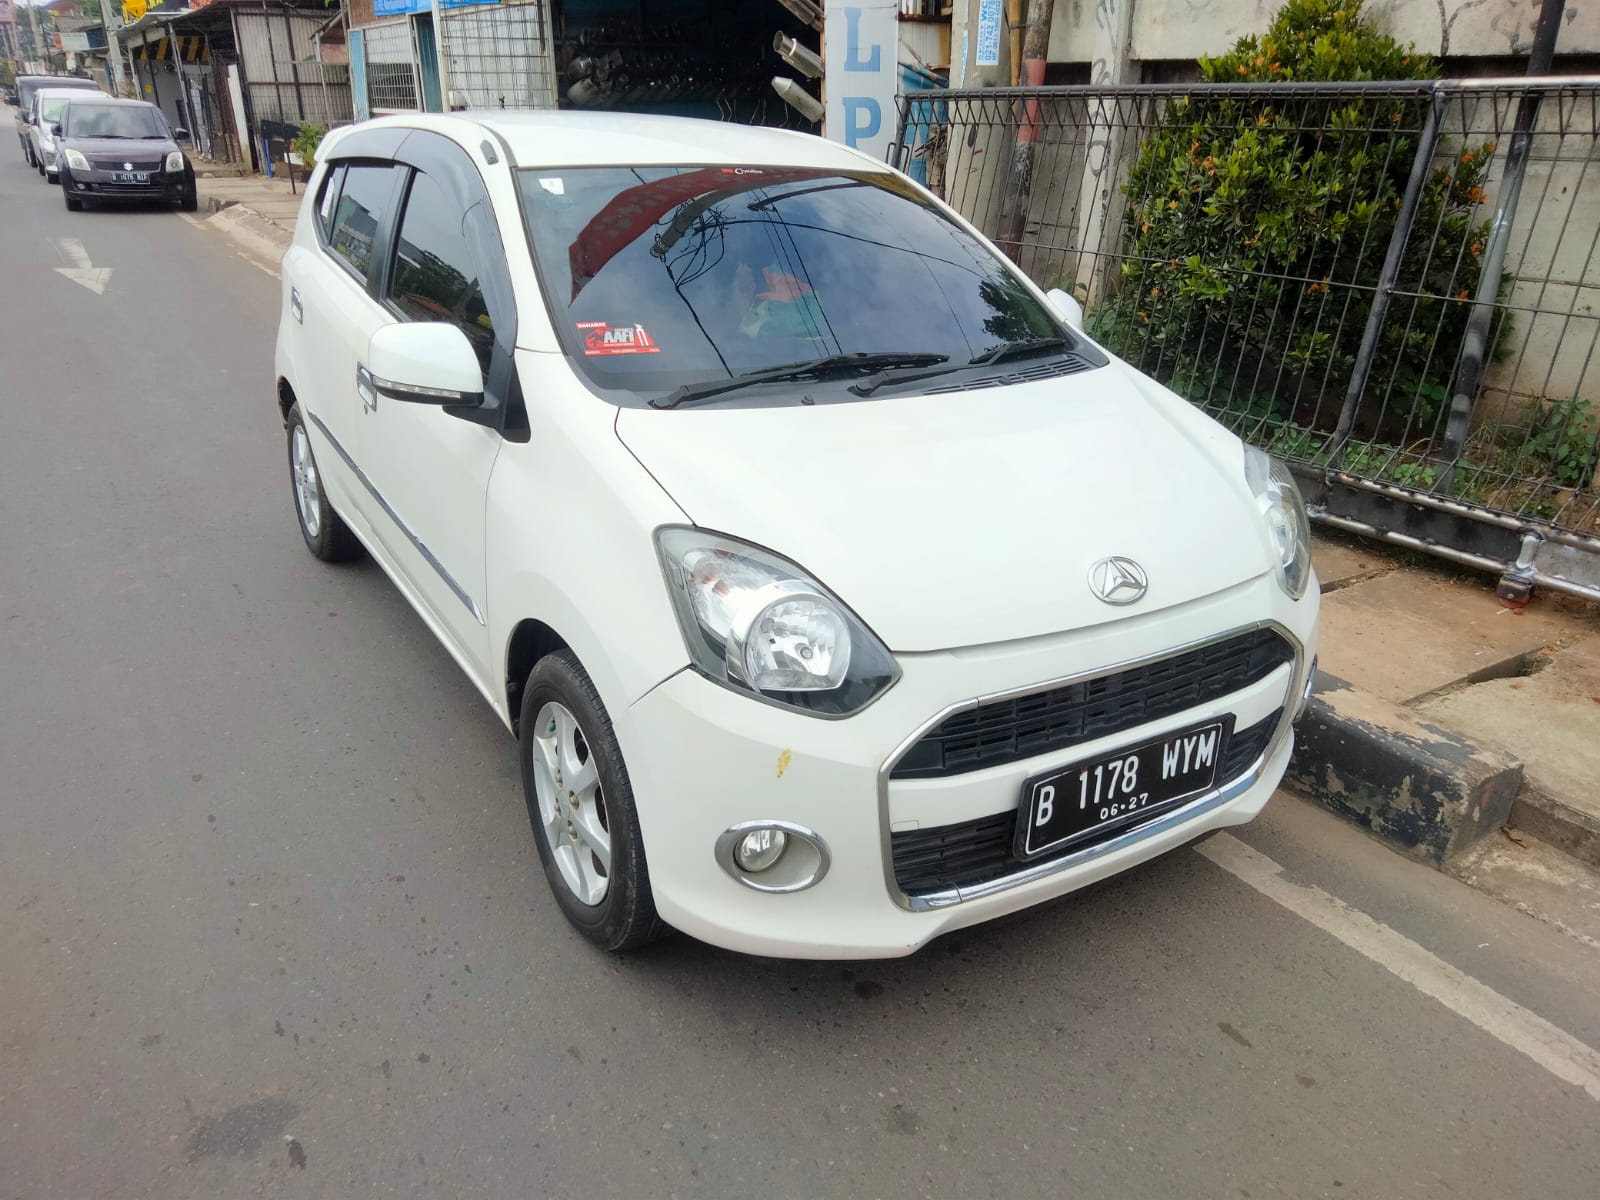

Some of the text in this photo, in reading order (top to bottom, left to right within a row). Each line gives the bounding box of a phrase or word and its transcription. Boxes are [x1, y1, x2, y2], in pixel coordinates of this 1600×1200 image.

[1035, 730, 1216, 827] B 1178 WYM
